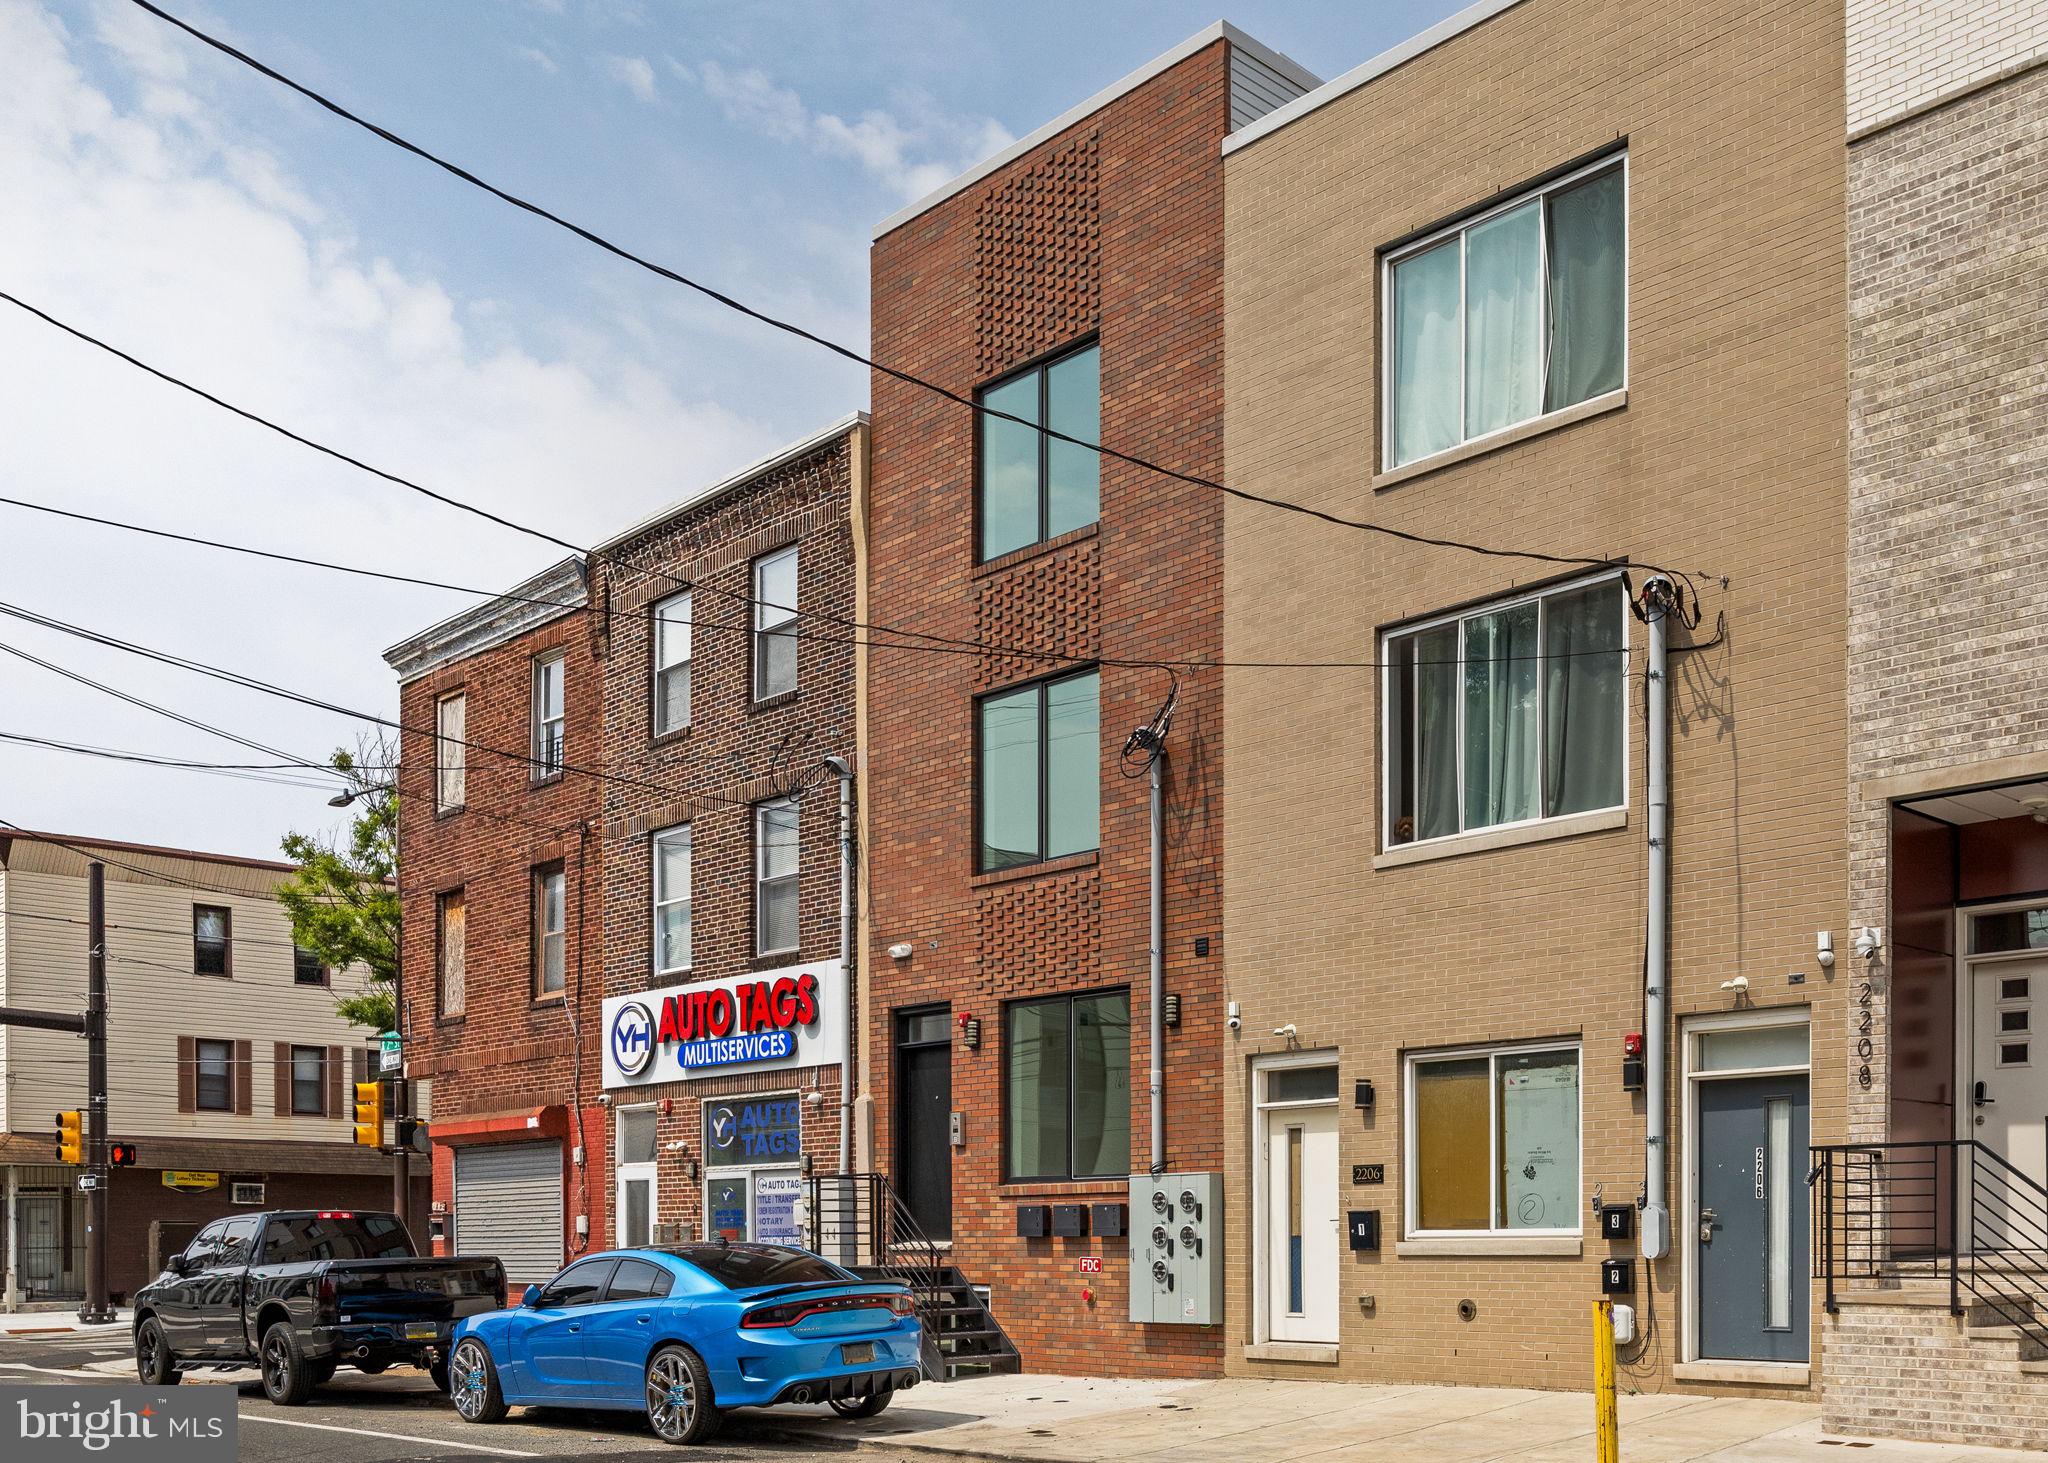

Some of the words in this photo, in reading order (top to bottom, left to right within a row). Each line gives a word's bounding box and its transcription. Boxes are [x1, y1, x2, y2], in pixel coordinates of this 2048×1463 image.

[657, 987, 736, 1044] AUTO
[736, 973, 819, 1032] TAGS
[617, 1022, 650, 1053] YH
[1858, 983, 1871, 1084] 2208
[684, 1033, 787, 1066] MULTISERVICES
[741, 1103, 800, 1127] AUTO
[741, 1130, 800, 1157] TAGS
[1355, 1167, 1380, 1181] 2206
[768, 1181, 786, 1190] AUTO
[757, 1195, 772, 1204] TITLE
[1612, 1215, 1619, 1228] 3
[1081, 1259, 1100, 1271] FDC
[1612, 1271, 1619, 1283] 2
